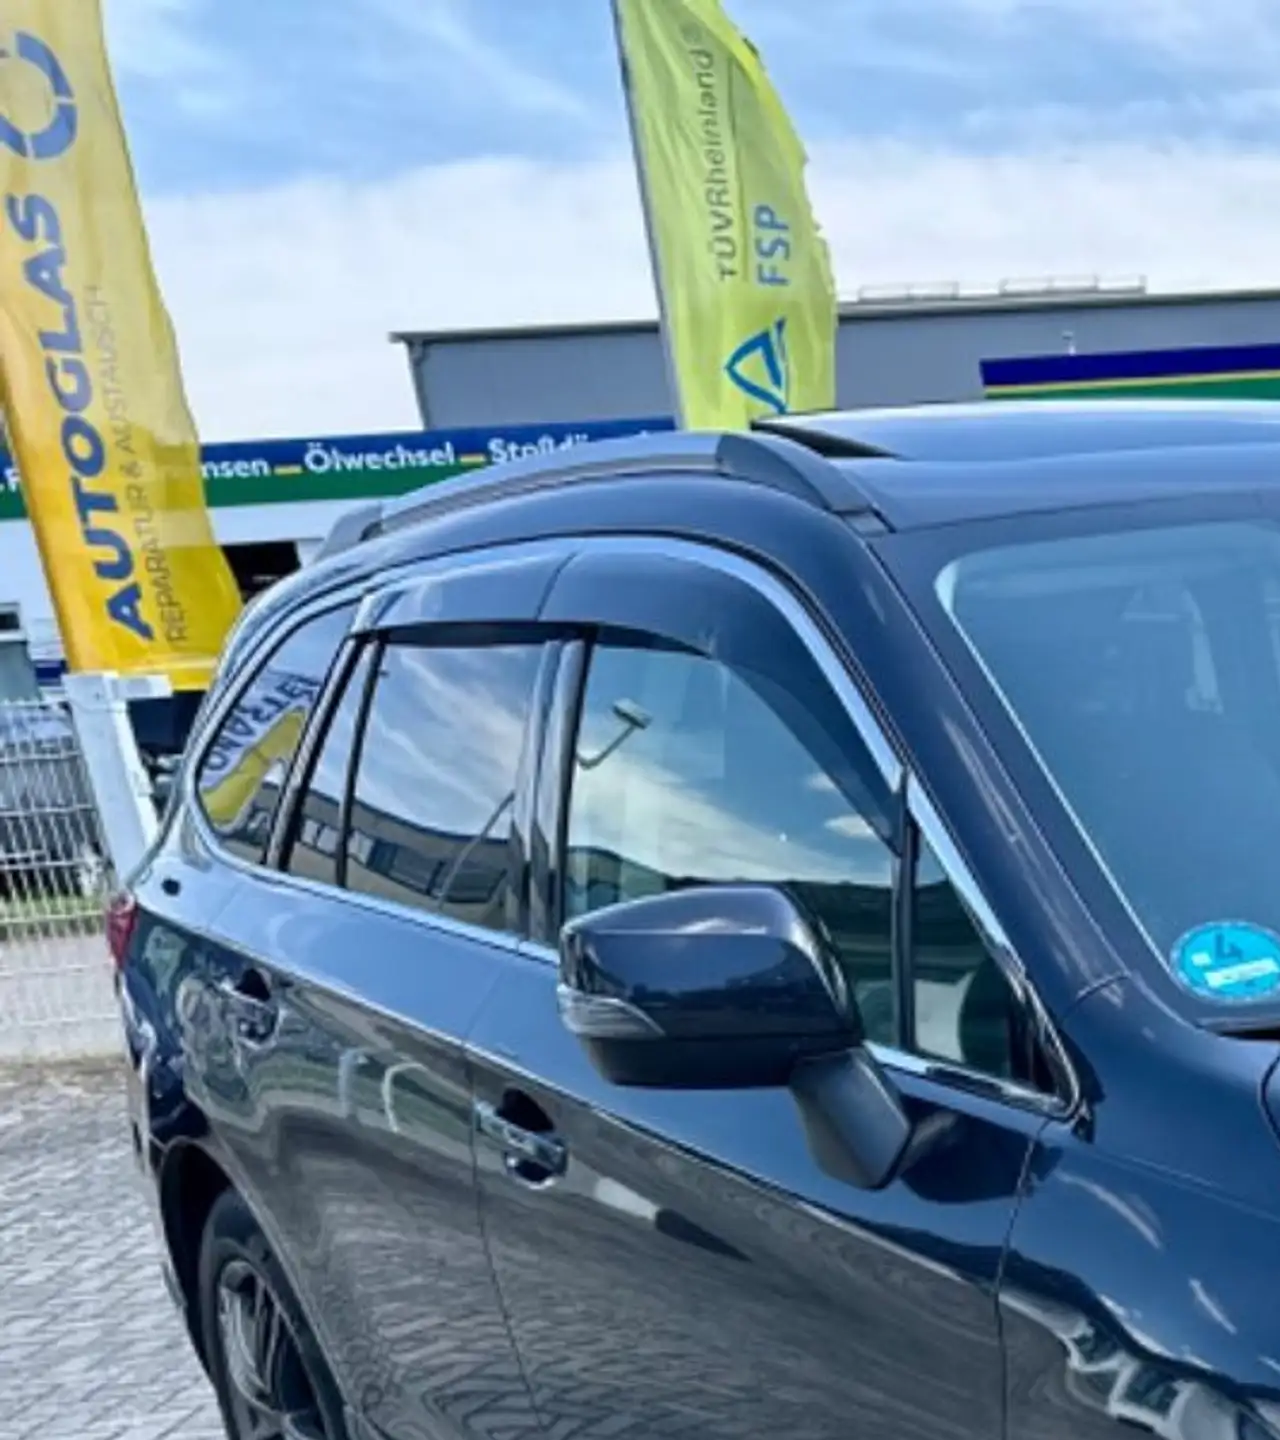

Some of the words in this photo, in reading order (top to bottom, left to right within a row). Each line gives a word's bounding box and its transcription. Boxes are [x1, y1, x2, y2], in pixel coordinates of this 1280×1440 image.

[754, 203, 790, 287] FSP
[6, 192, 155, 641] AUTOGLAS
[83, 284, 137, 455] AUSTAUSCH
[303, 440, 456, 474] Ölwechsel
[126, 483, 188, 644] REPARATUR
